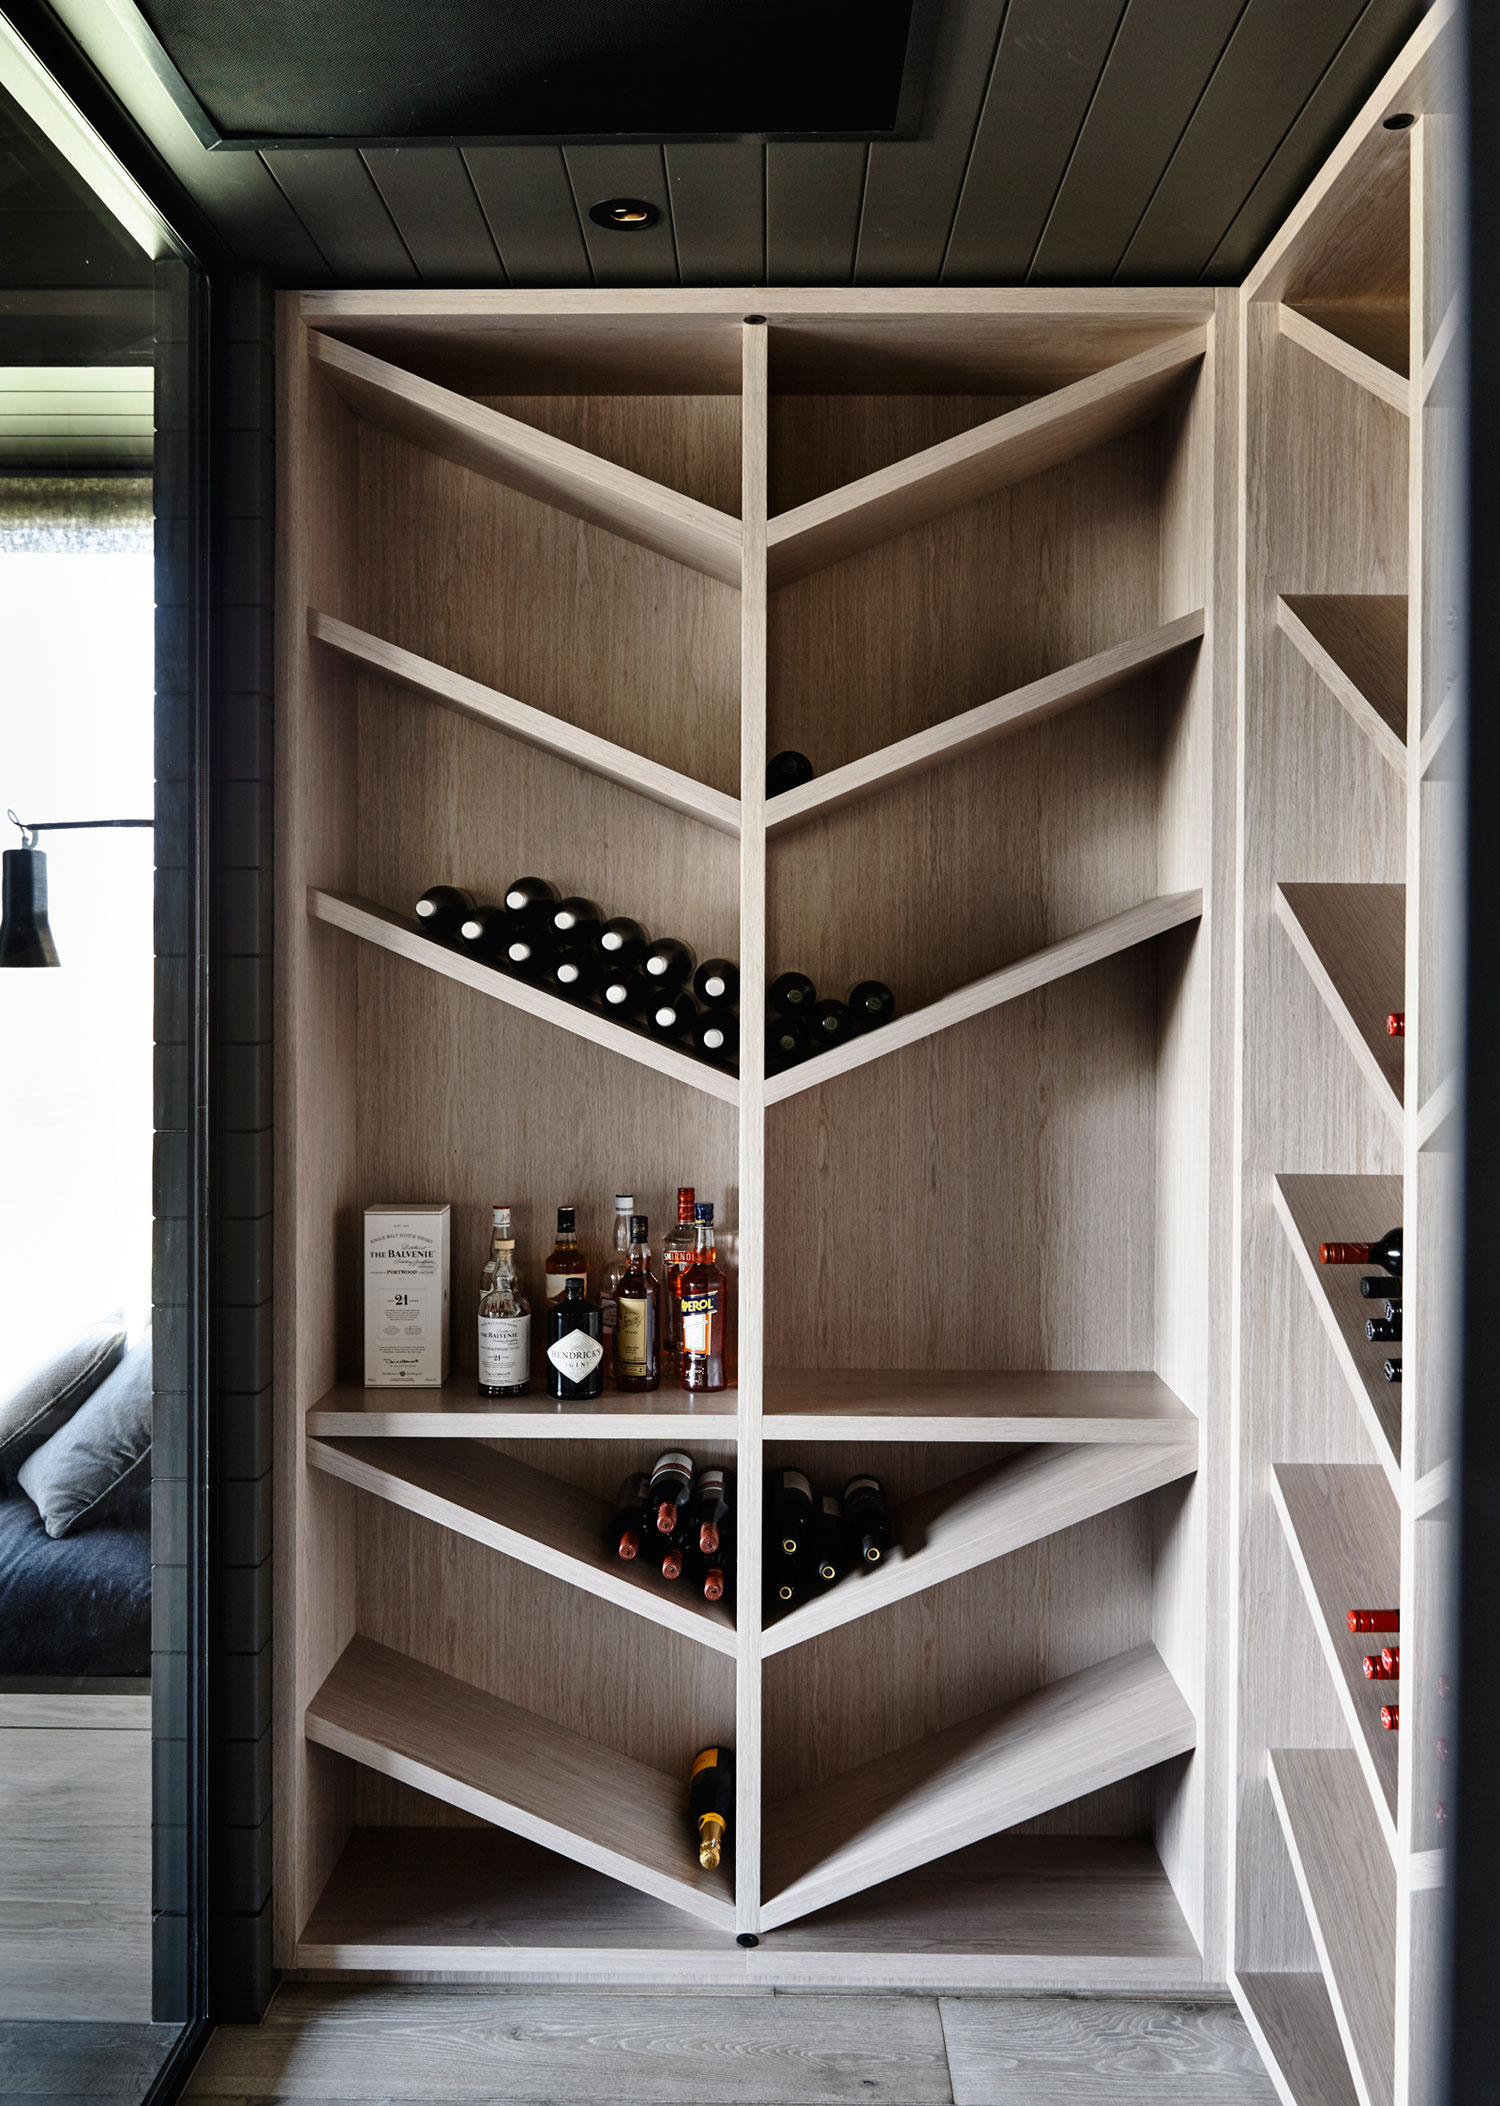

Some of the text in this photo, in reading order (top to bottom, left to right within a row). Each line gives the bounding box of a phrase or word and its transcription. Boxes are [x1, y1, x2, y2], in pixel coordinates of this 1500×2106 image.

[388, 1249, 434, 1258] BALVENIE
[394, 1294, 408, 1305] 21
[488, 1331, 518, 1339] BALVENIE
[551, 1348, 601, 1360] HENDRICK'S
